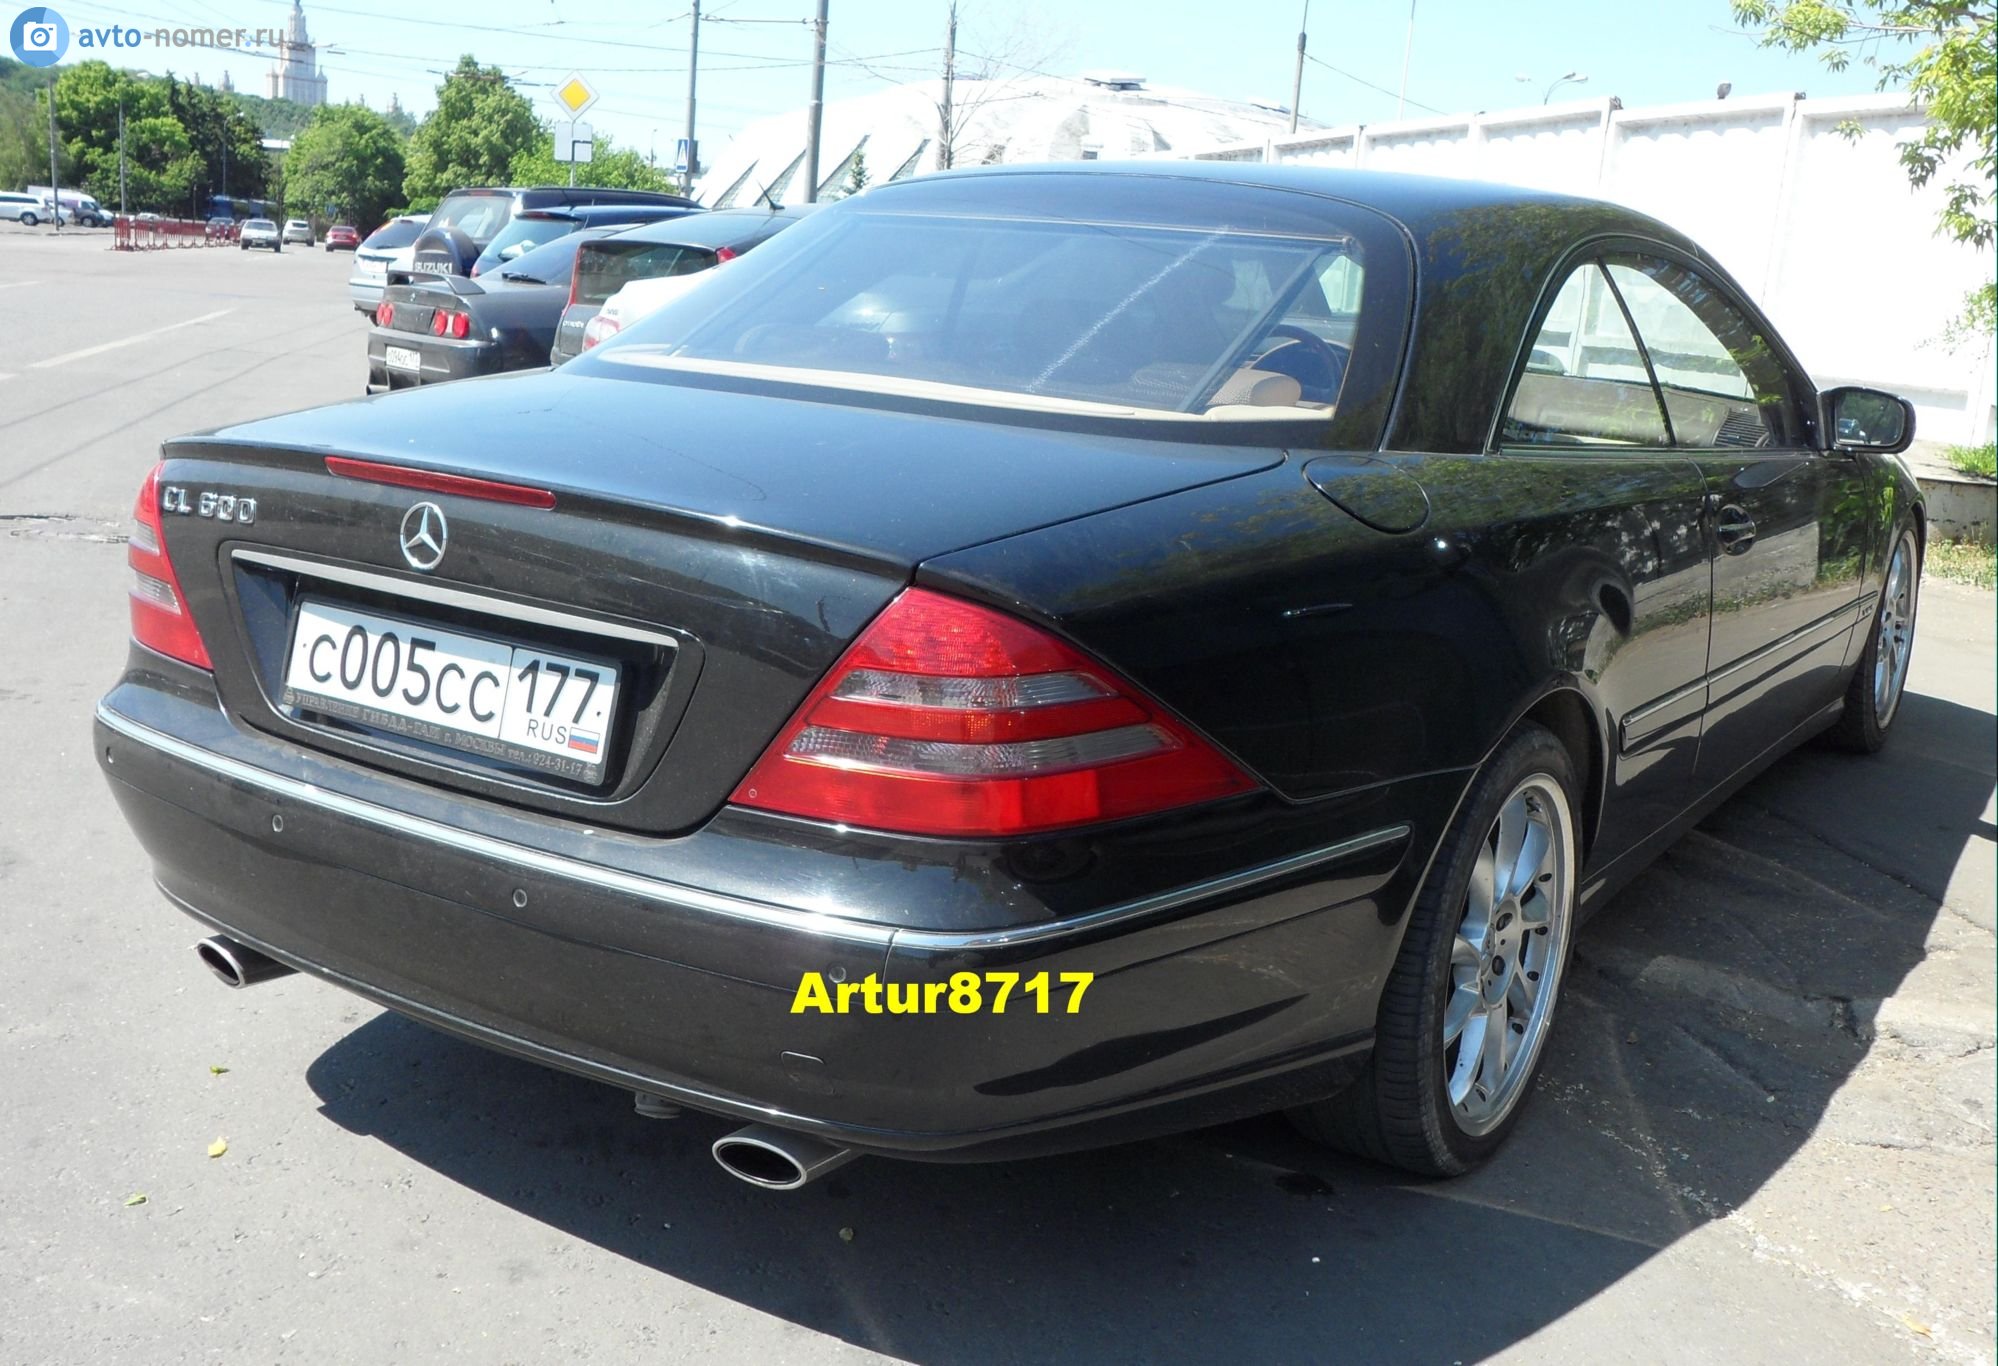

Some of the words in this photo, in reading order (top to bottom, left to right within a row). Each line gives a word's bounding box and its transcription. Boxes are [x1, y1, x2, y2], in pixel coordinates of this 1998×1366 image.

[414, 261, 453, 274] SUZUKI
[162, 486, 192, 514] CL
[198, 491, 257, 525] 600
[518, 659, 600, 725] 177
[295, 692, 360, 718] УПРАВЛЕНИЕ
[455, 732, 507, 757] МОСКВЫ
[526, 718, 568, 745] RUS
